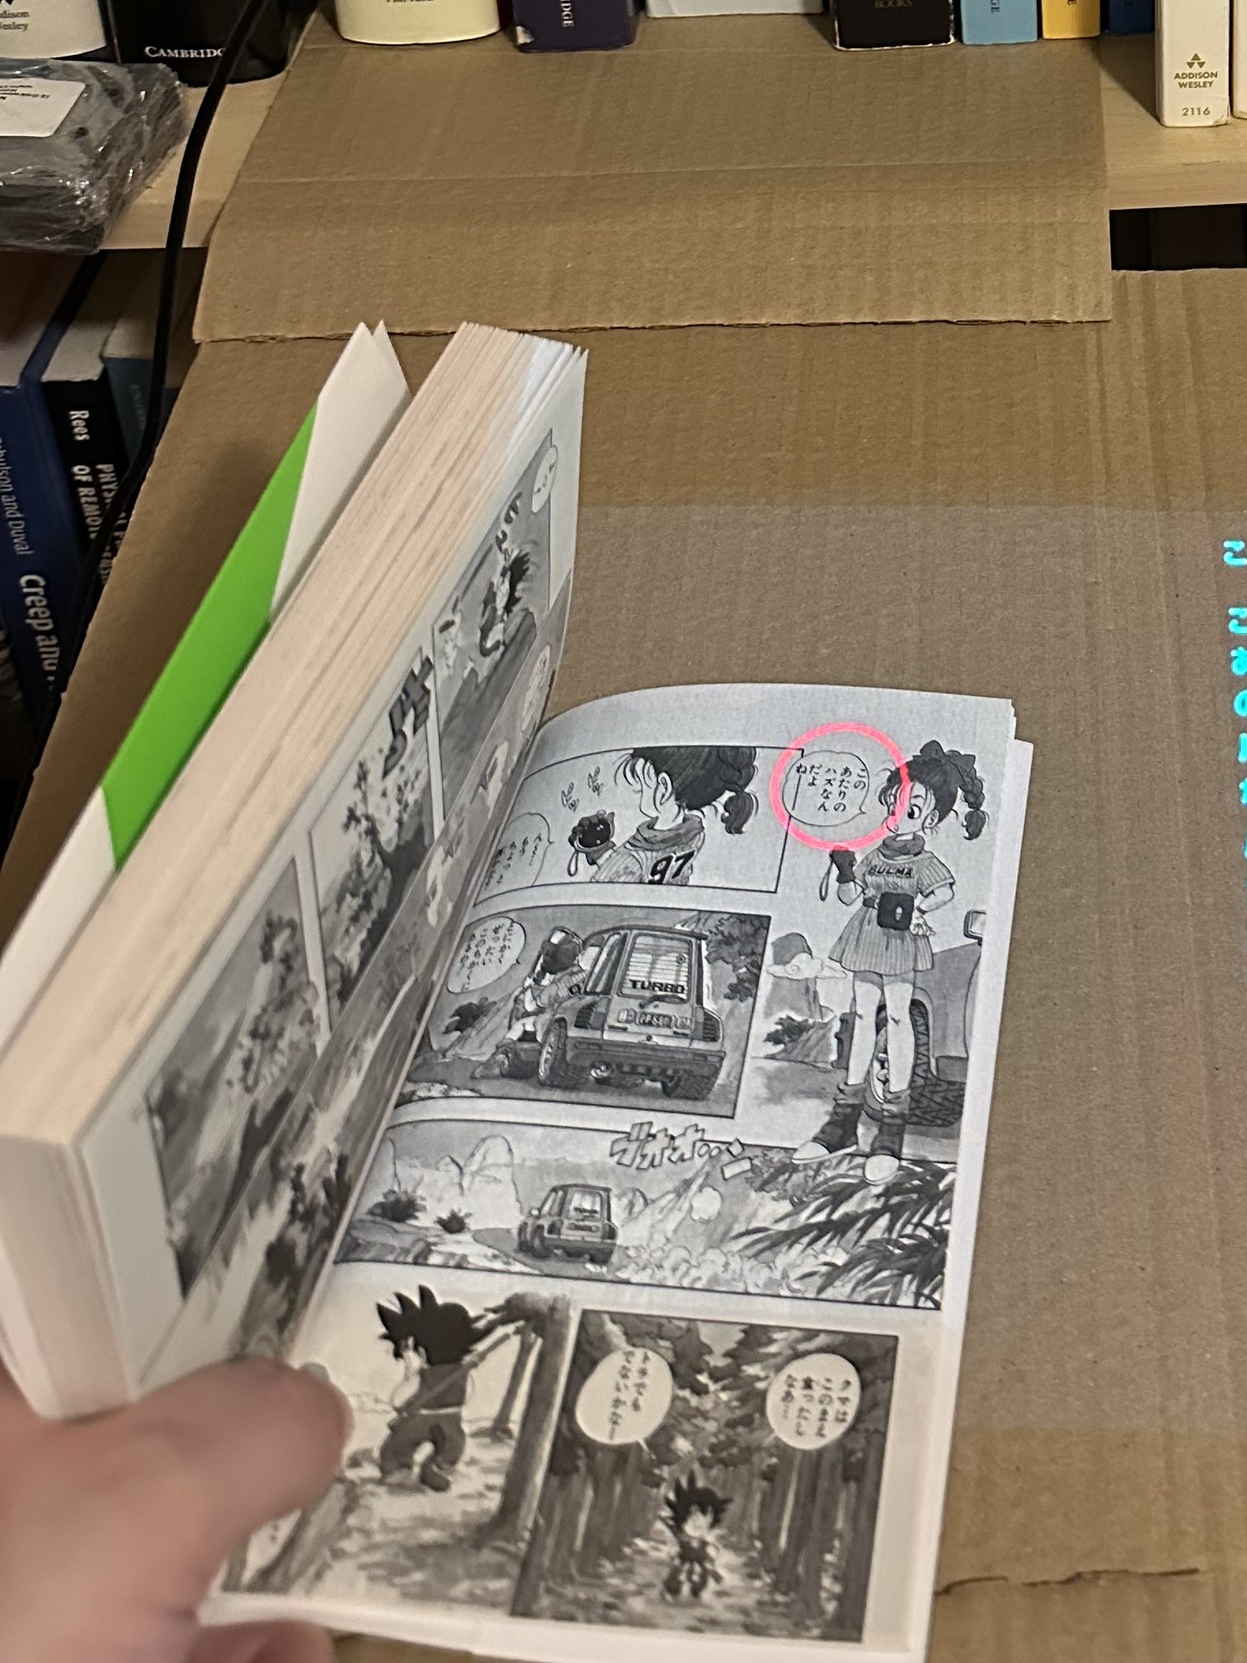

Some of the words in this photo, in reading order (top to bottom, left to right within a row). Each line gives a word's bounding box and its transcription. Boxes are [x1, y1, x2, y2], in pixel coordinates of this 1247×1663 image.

[1181, 106, 1211, 117] 2116
[69, 409, 90, 443] Rees
[20, 573, 54, 632] Creep
[792, 763, 807, 811] ねー
[808, 764, 823, 786] だよ
[834, 766, 852, 812] あたりの
[854, 768, 867, 790] この
[818, 768, 837, 812] ハズなん
[869, 864, 913, 879] BULMA
[630, 979, 686, 994] TURBO
